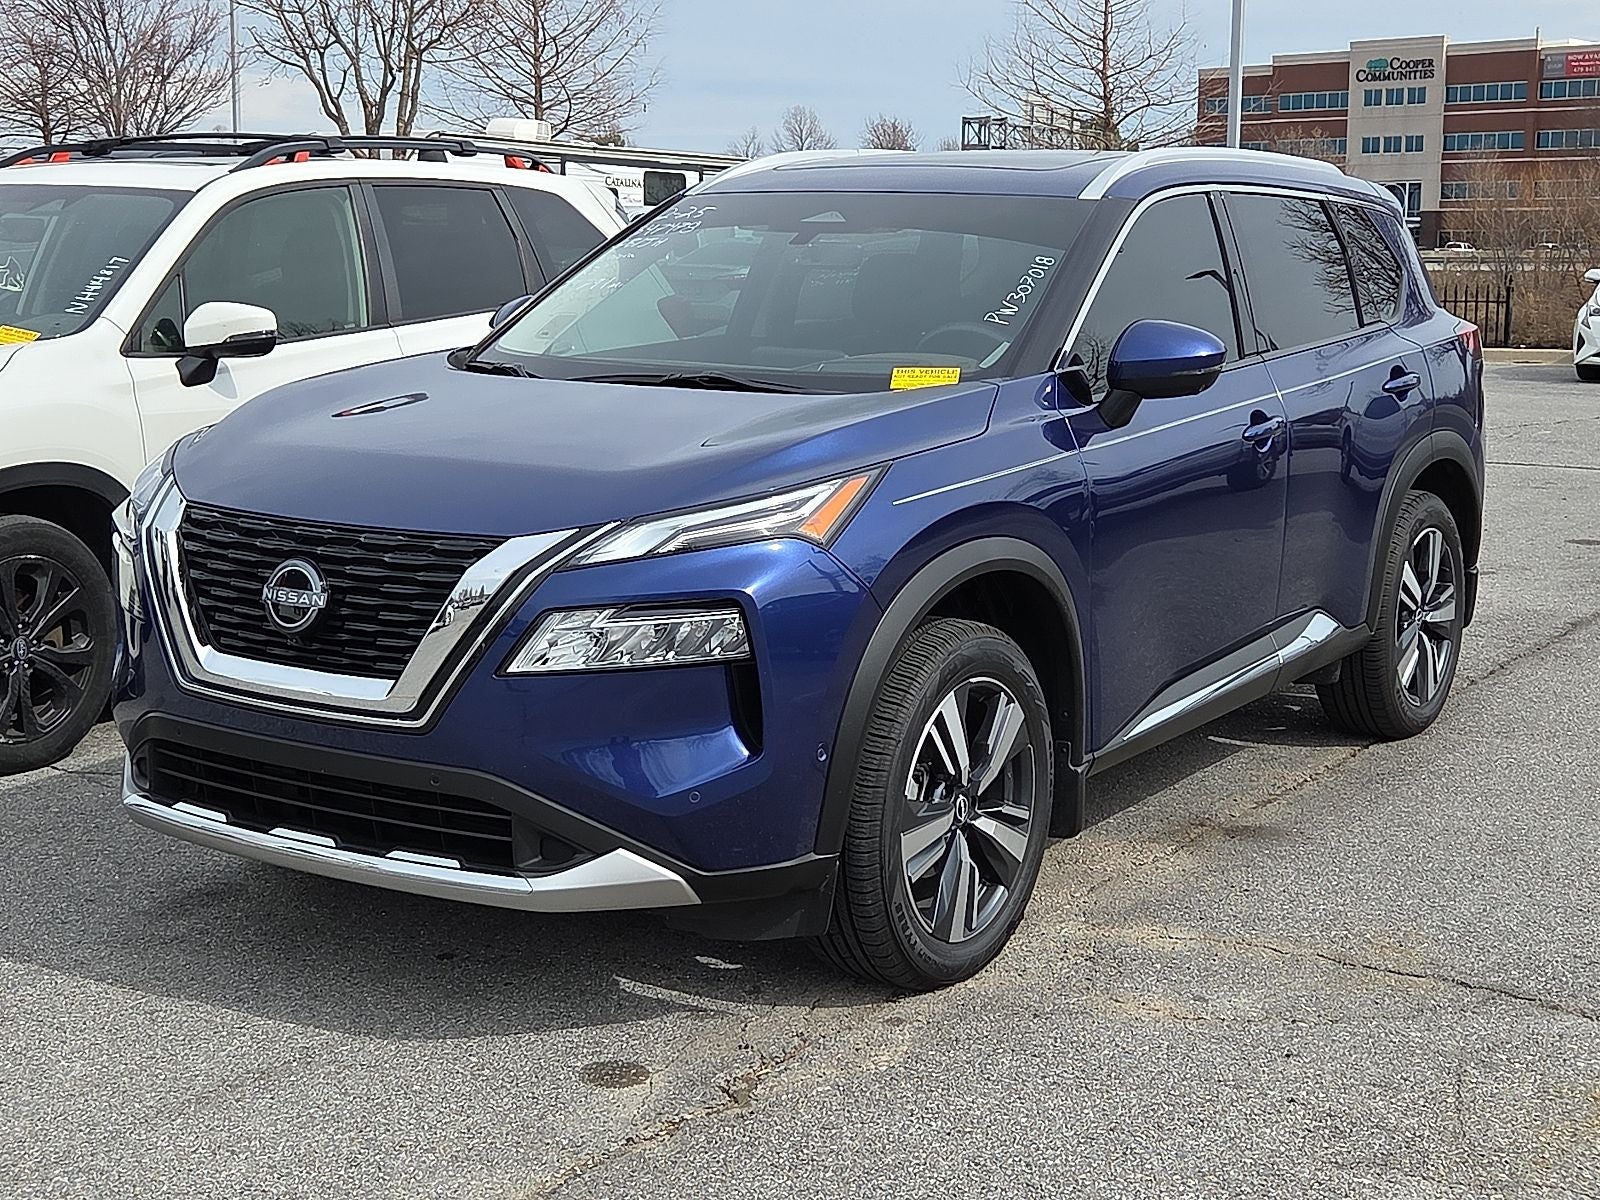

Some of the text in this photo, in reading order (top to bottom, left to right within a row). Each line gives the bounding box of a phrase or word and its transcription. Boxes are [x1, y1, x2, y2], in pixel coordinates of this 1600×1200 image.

[1390, 57, 1435, 70] COOPER
[1356, 69, 1435, 82] COMMUNITIES
[605, 176, 643, 188] CATALINA
[983, 255, 1055, 325] PW307018
[264, 585, 325, 606] NISSAN
